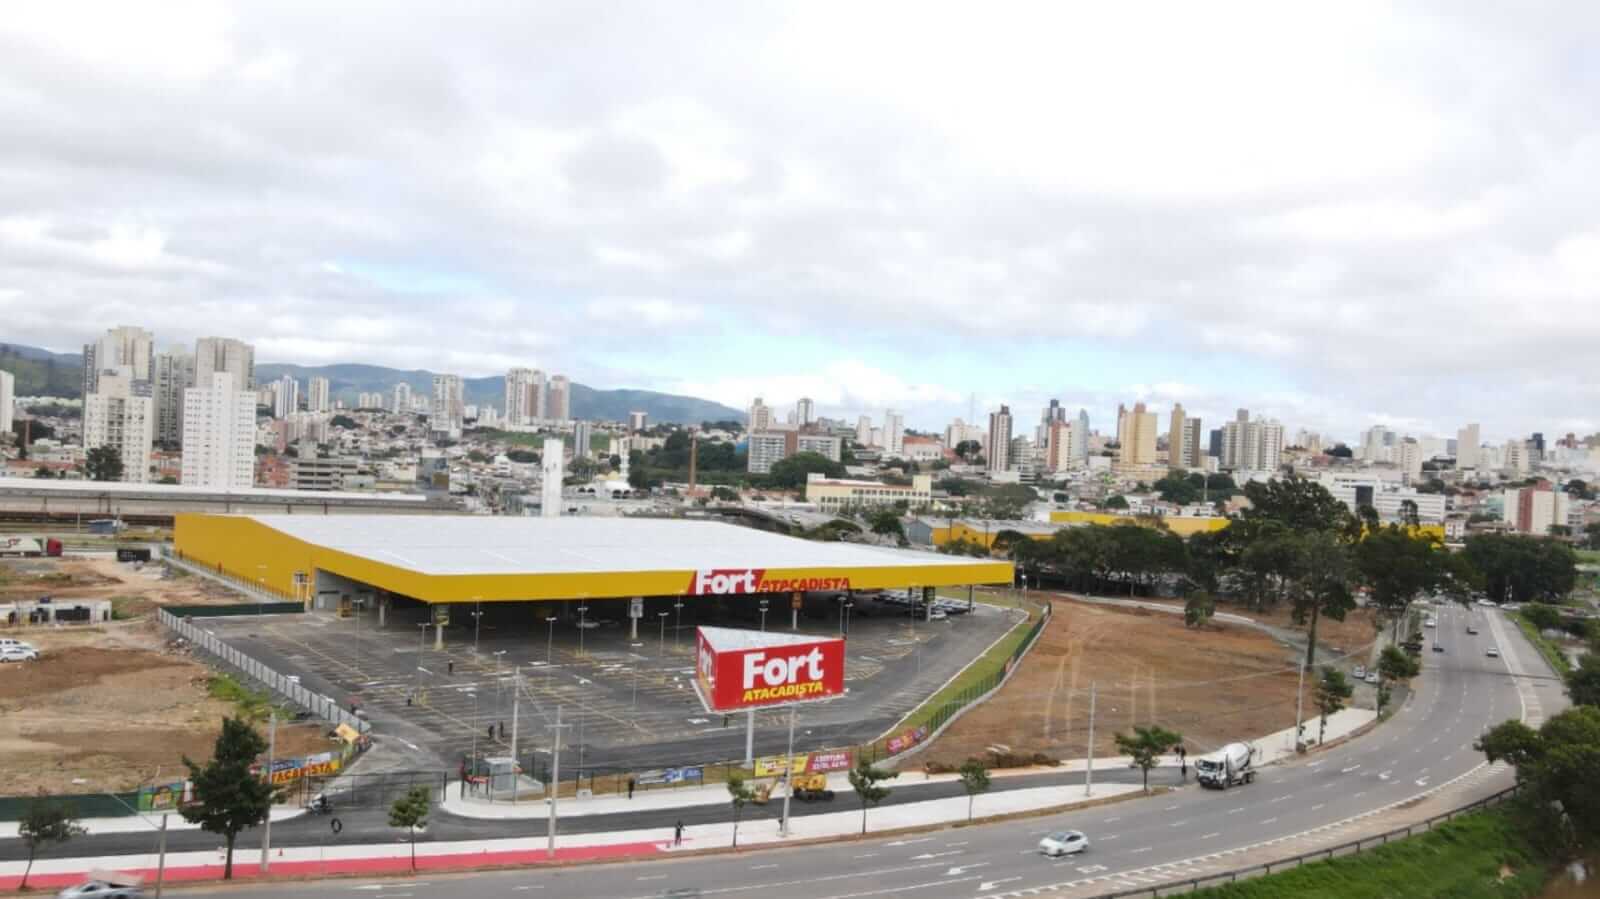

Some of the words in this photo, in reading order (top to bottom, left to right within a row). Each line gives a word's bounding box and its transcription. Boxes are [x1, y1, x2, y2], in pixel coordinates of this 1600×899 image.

[695, 569, 757, 595] Fort
[759, 577, 850, 593] ATACADISTA
[743, 647, 824, 688] Fort
[743, 681, 824, 702] ATACADISTA
